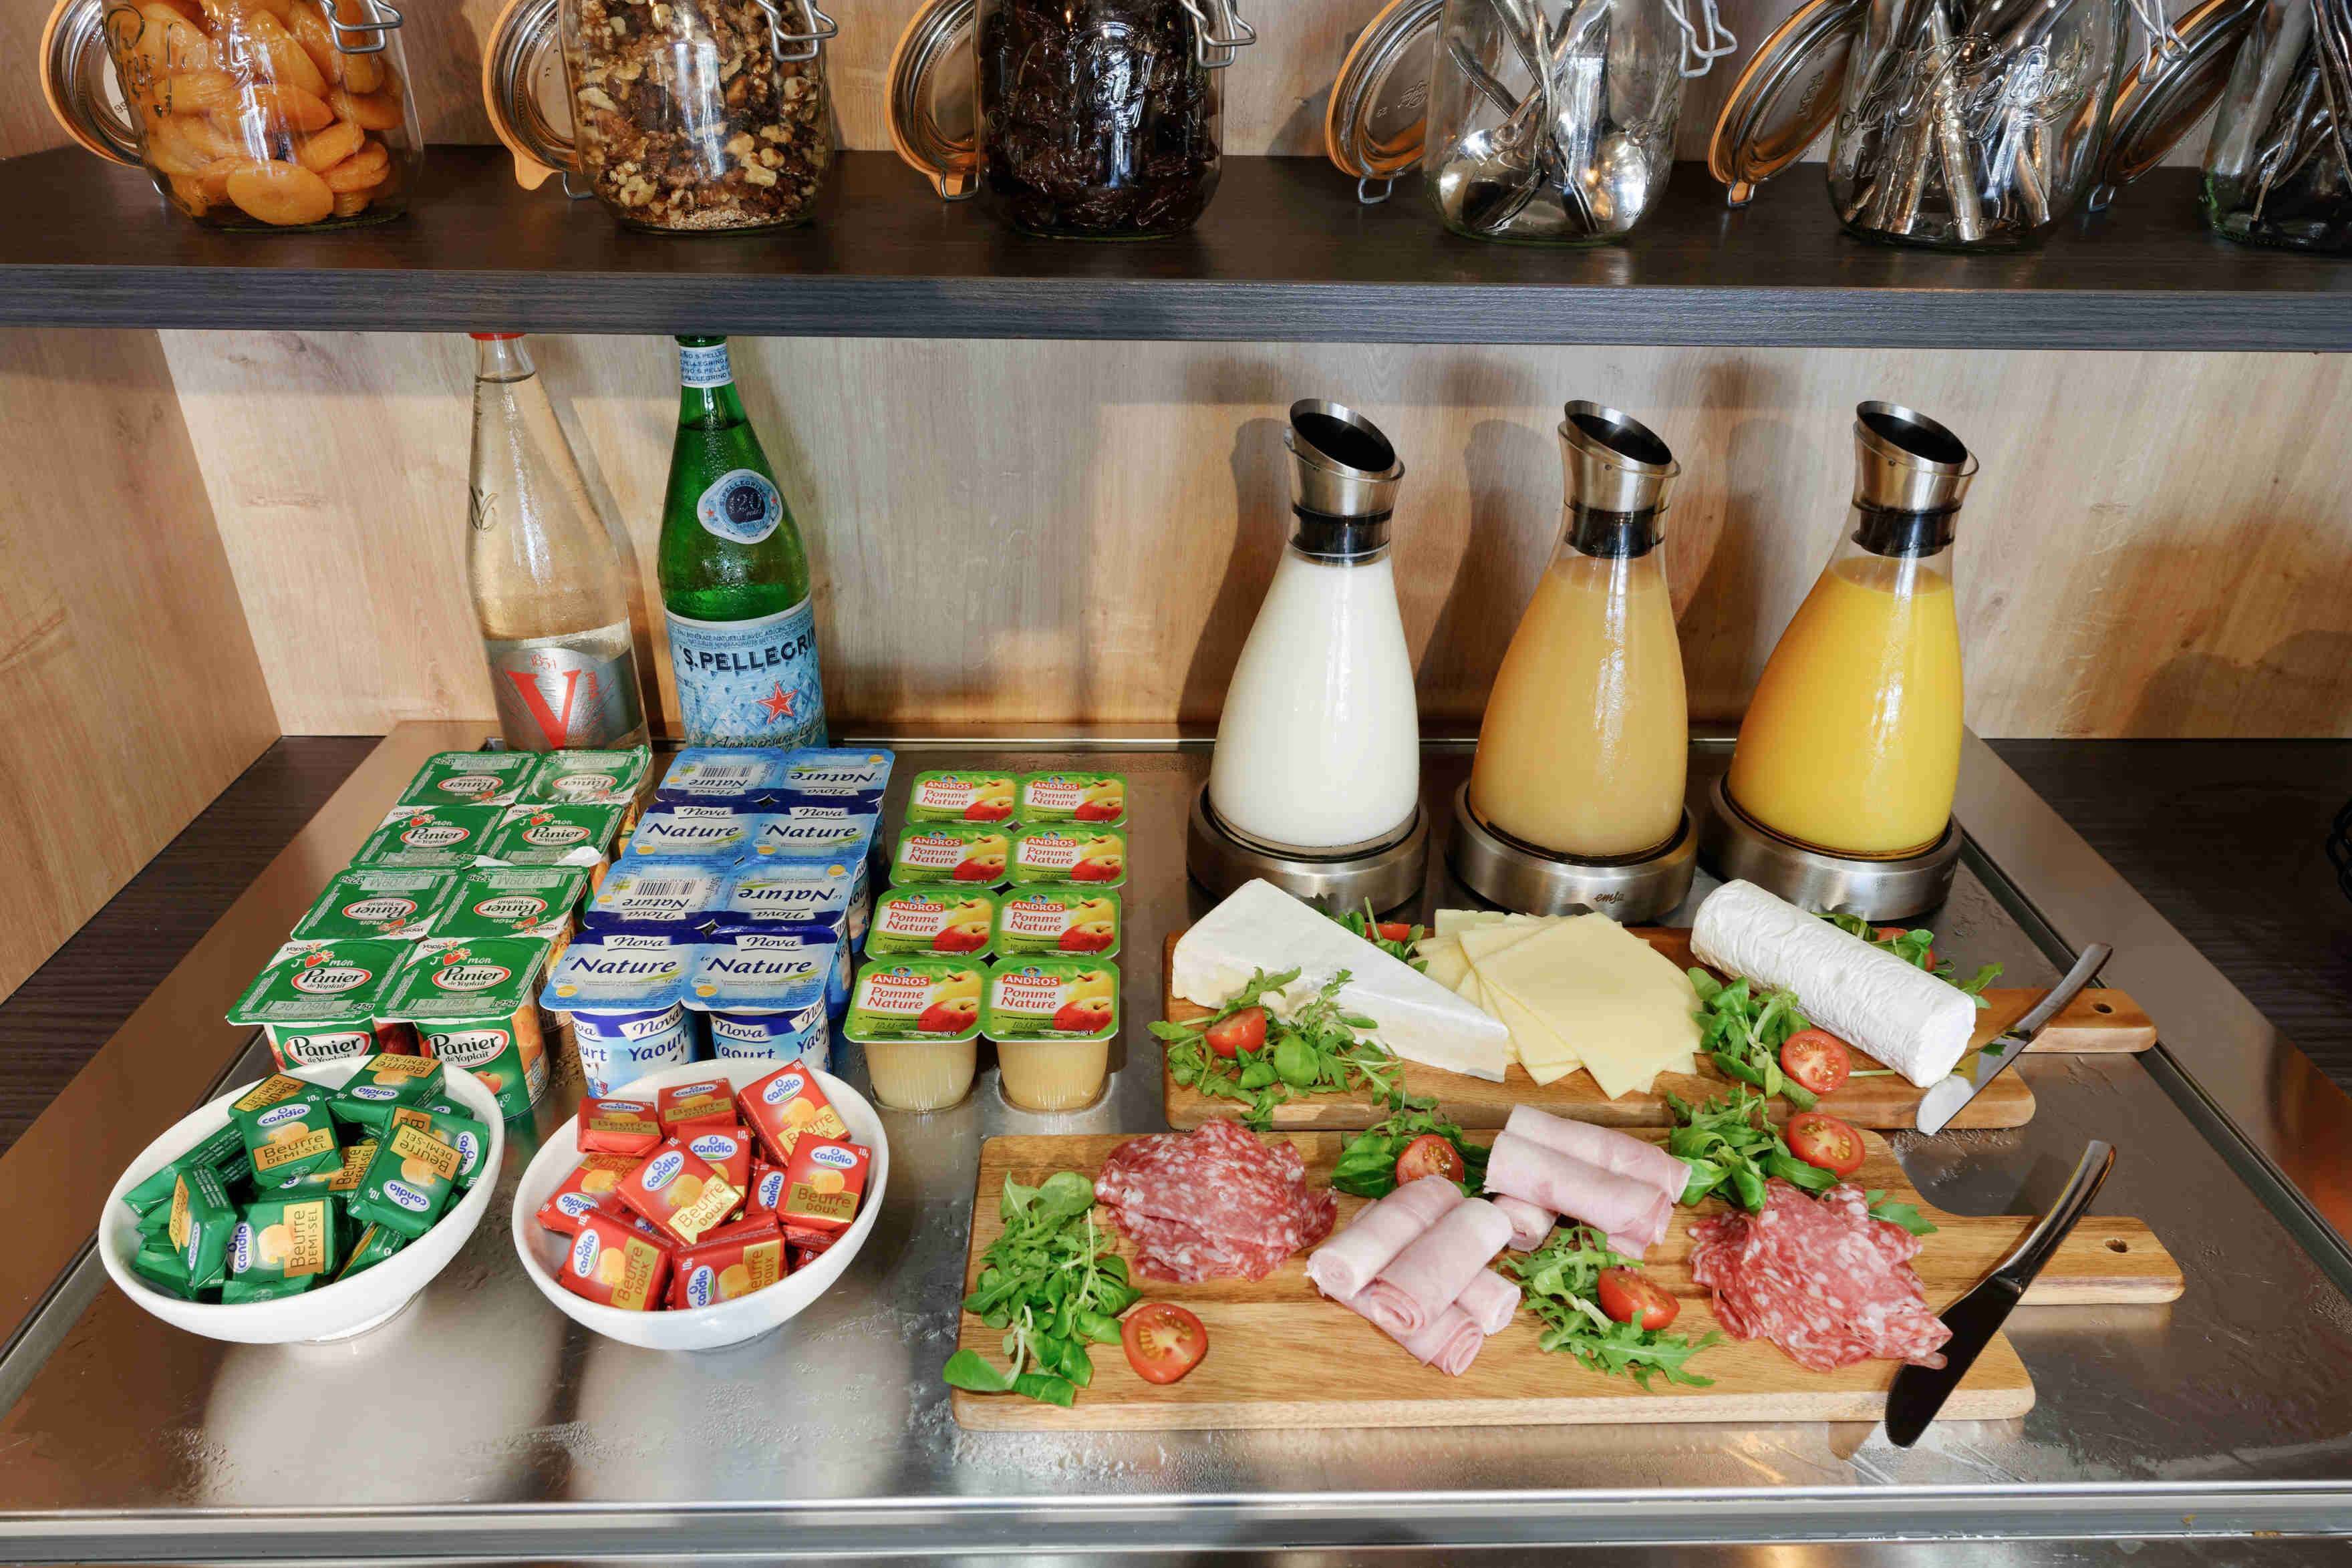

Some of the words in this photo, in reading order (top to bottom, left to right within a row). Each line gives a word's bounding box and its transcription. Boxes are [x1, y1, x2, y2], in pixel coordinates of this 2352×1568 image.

[689, 779, 748, 788] Nature
[790, 771, 876, 783] Nature
[927, 782, 971, 790] ANDROS
[1034, 782, 1079, 790] ANDROS
[924, 789, 968, 798] Pomme
[1033, 790, 1077, 799] Pomme
[922, 796, 968, 806] Nature
[1031, 797, 1077, 806] Nature
[410, 828, 462, 839] Panier
[531, 826, 583, 838] Panier
[646, 822, 740, 838] Nature
[765, 824, 858, 838] Nature
[913, 837, 961, 846] ANDROS
[1028, 838, 1074, 847] ANDROS
[911, 846, 958, 856] Pomme
[1026, 846, 1073, 857] Pomme
[908, 854, 958, 865] Nature
[1025, 854, 1074, 865] Nature
[738, 887, 836, 903] Nature
[621, 897, 690, 909] Nature
[891, 902, 941, 912] ANDROS
[1013, 902, 1064, 912] ANDROS
[350, 906, 407, 919] Panier
[482, 904, 538, 917] Panier
[889, 911, 939, 923] Pomme
[1012, 911, 1062, 923] Pomme
[885, 920, 939, 932] Nature
[1010, 920, 1062, 932] Nature
[467, 956, 493, 964] mon
[569, 957, 678, 974] Nature
[706, 957, 813, 974] Nature
[302, 968, 363, 984] Panier
[442, 965, 502, 982] Panier
[873, 975, 928, 986] ANDROS
[1004, 975, 1059, 986] ANDROS
[870, 986, 925, 999] Pomme
[1003, 986, 1056, 999] Pomme
[867, 997, 923, 1009] Nature
[1001, 996, 1056, 1009] Nature
[288, 1036, 361, 1058] Panier
[428, 1033, 499, 1056] Panier
[627, 1024, 690, 1063] Yaourt
[383, 1054, 432, 1067] DEMI-SEL
[454, 1050, 490, 1064] Yoplait
[376, 1060, 426, 1075] Beurre
[357, 1086, 396, 1098] candia
[766, 1078, 800, 1102] candia
[261, 1106, 306, 1125] candia
[263, 1134, 325, 1160] Beurre
[405, 1130, 454, 1161] DEMI-SEL
[692, 1140, 733, 1154] candia
[267, 1142, 327, 1165] DEMI-SEL
[400, 1138, 450, 1173] Beurre
[814, 1149, 853, 1165] candia
[336, 1148, 361, 1186] Beurre
[647, 1154, 680, 1189] candia
[390, 1182, 428, 1207] candia
[766, 1174, 782, 1207] candia
[678, 1181, 725, 1228] Beurre
[797, 1187, 851, 1209] Beurre
[805, 1203, 839, 1215] DOUX
[289, 1209, 305, 1269] Beurre
[308, 1207, 318, 1265] DEMI-SEL
[235, 1225, 248, 1269] candia
[578, 1235, 595, 1274] candia
[617, 1245, 644, 1302] Beurre
[750, 1249, 764, 1289] eurre
[697, 1269, 708, 1307] candia
